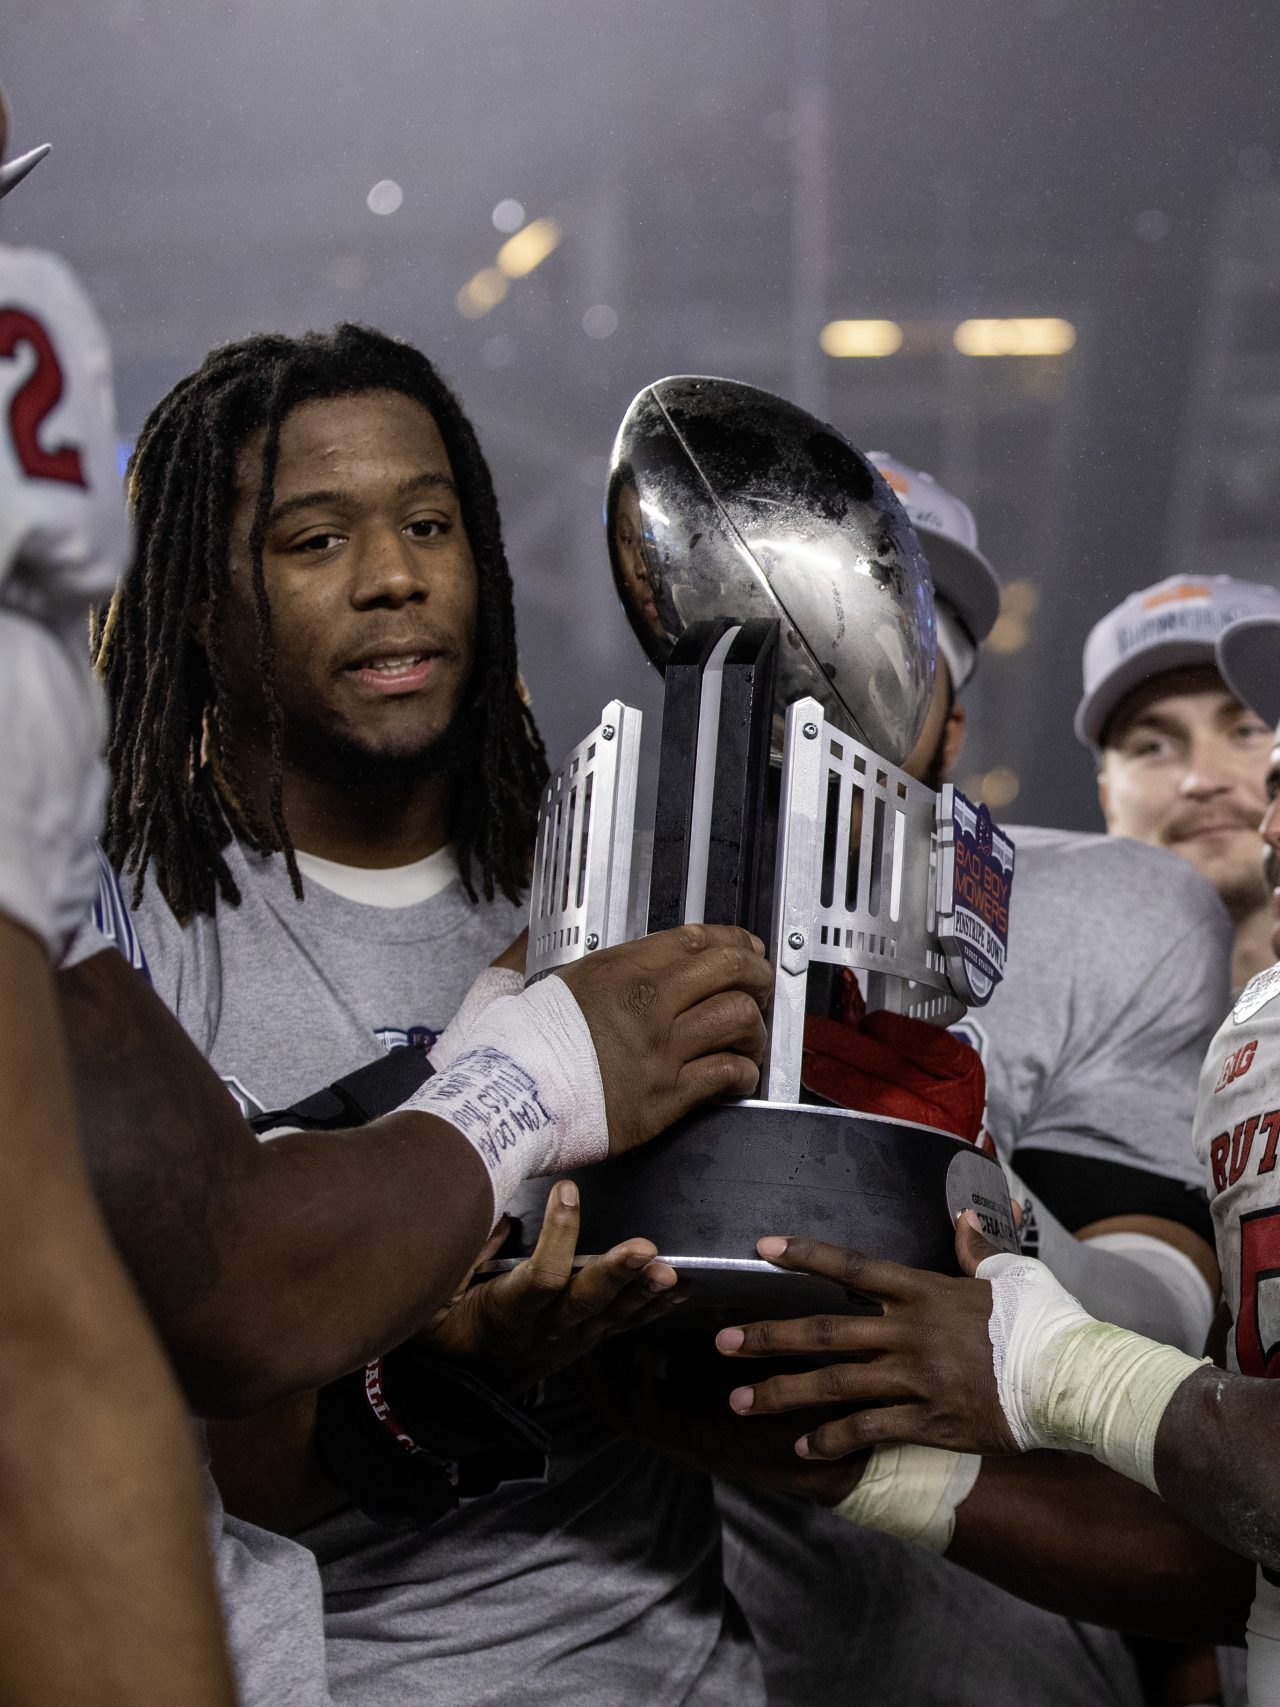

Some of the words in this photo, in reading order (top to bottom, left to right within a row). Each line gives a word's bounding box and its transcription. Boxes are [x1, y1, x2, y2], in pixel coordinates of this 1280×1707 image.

[955, 865, 1008, 933] MOWERS
[956, 839, 982, 881] BAD
[984, 864, 1009, 900] BOY
[955, 910, 986, 949] PINSTRIPE
[986, 931, 1004, 971] BOWL
